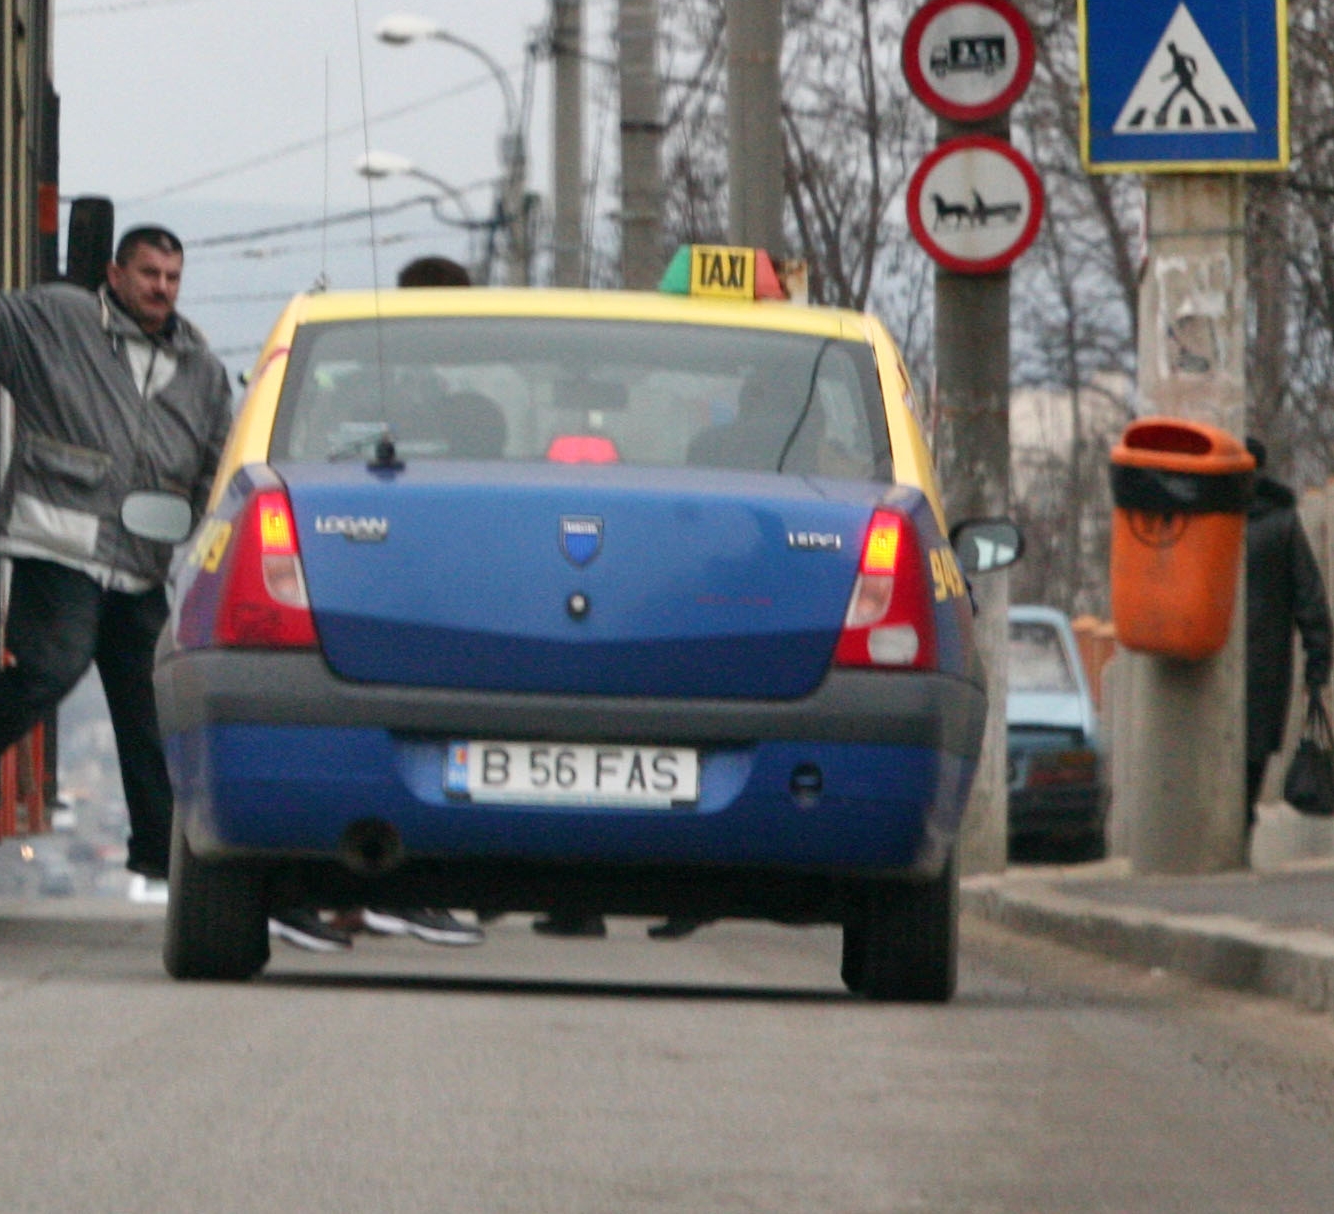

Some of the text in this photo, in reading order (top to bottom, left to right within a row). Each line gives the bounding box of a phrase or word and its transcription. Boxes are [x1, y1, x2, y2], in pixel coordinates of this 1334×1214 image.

[698, 252, 747, 288] TAXI
[315, 515, 388, 536] LOGAN
[482, 748, 679, 792] B 56 FAS
